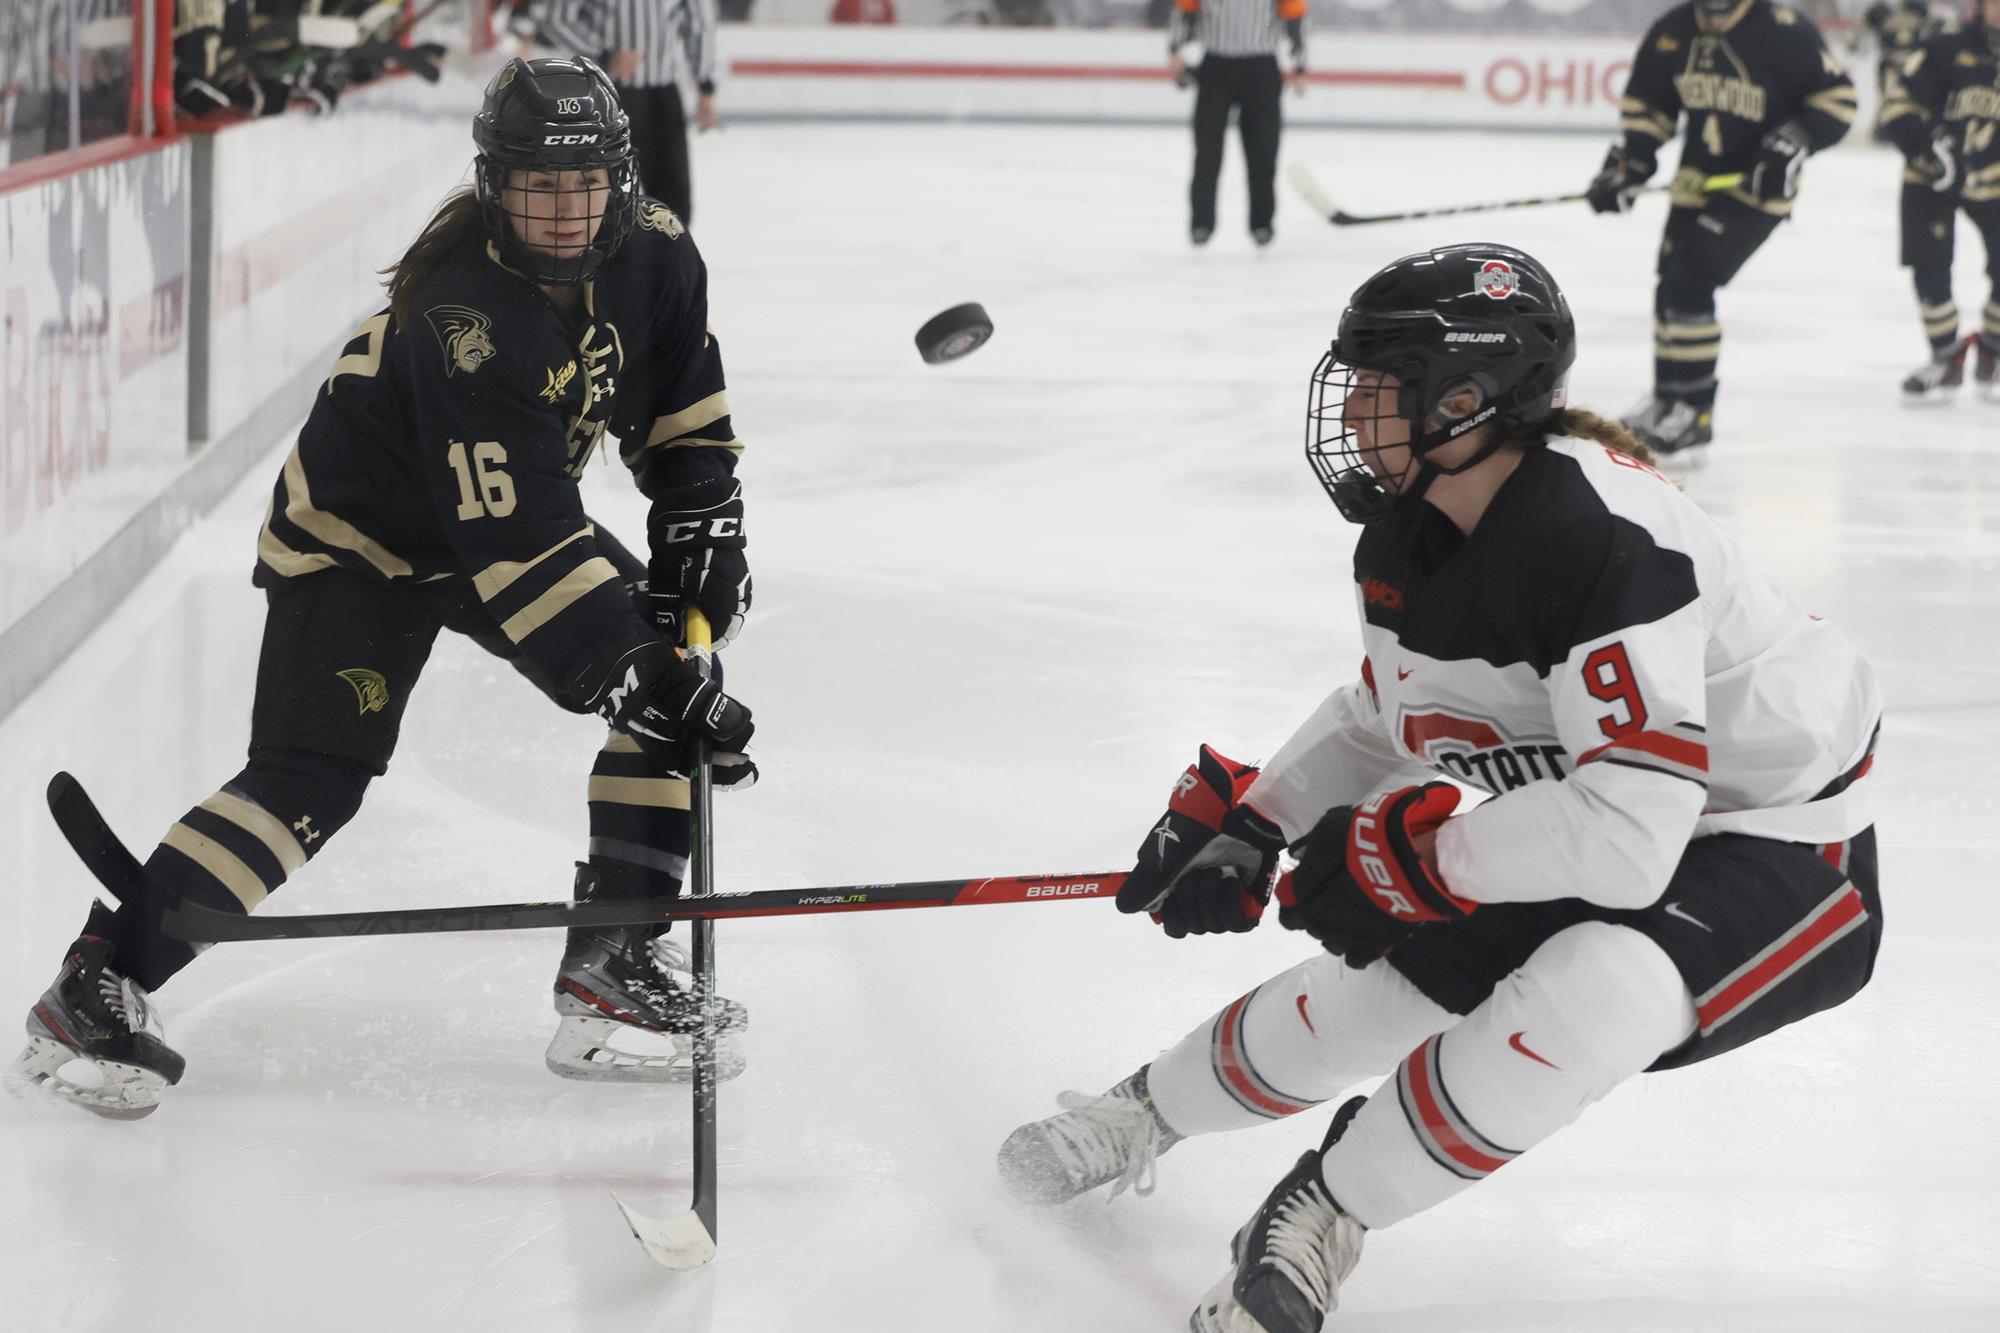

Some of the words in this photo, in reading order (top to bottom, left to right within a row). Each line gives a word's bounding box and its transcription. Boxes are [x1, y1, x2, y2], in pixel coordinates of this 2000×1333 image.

[557, 99, 581, 114] 16
[544, 134, 598, 145] CCM
[1702, 113, 1723, 156] 4
[1444, 332, 1506, 343] BAUER
[1450, 406, 1496, 437] BAUER
[448, 441, 517, 521] 16
[1581, 640, 1648, 741] 9
[1357, 792, 1416, 914] AUER
[799, 894, 867, 905] HYPERLITE
[1026, 883, 1099, 897] BAUER
